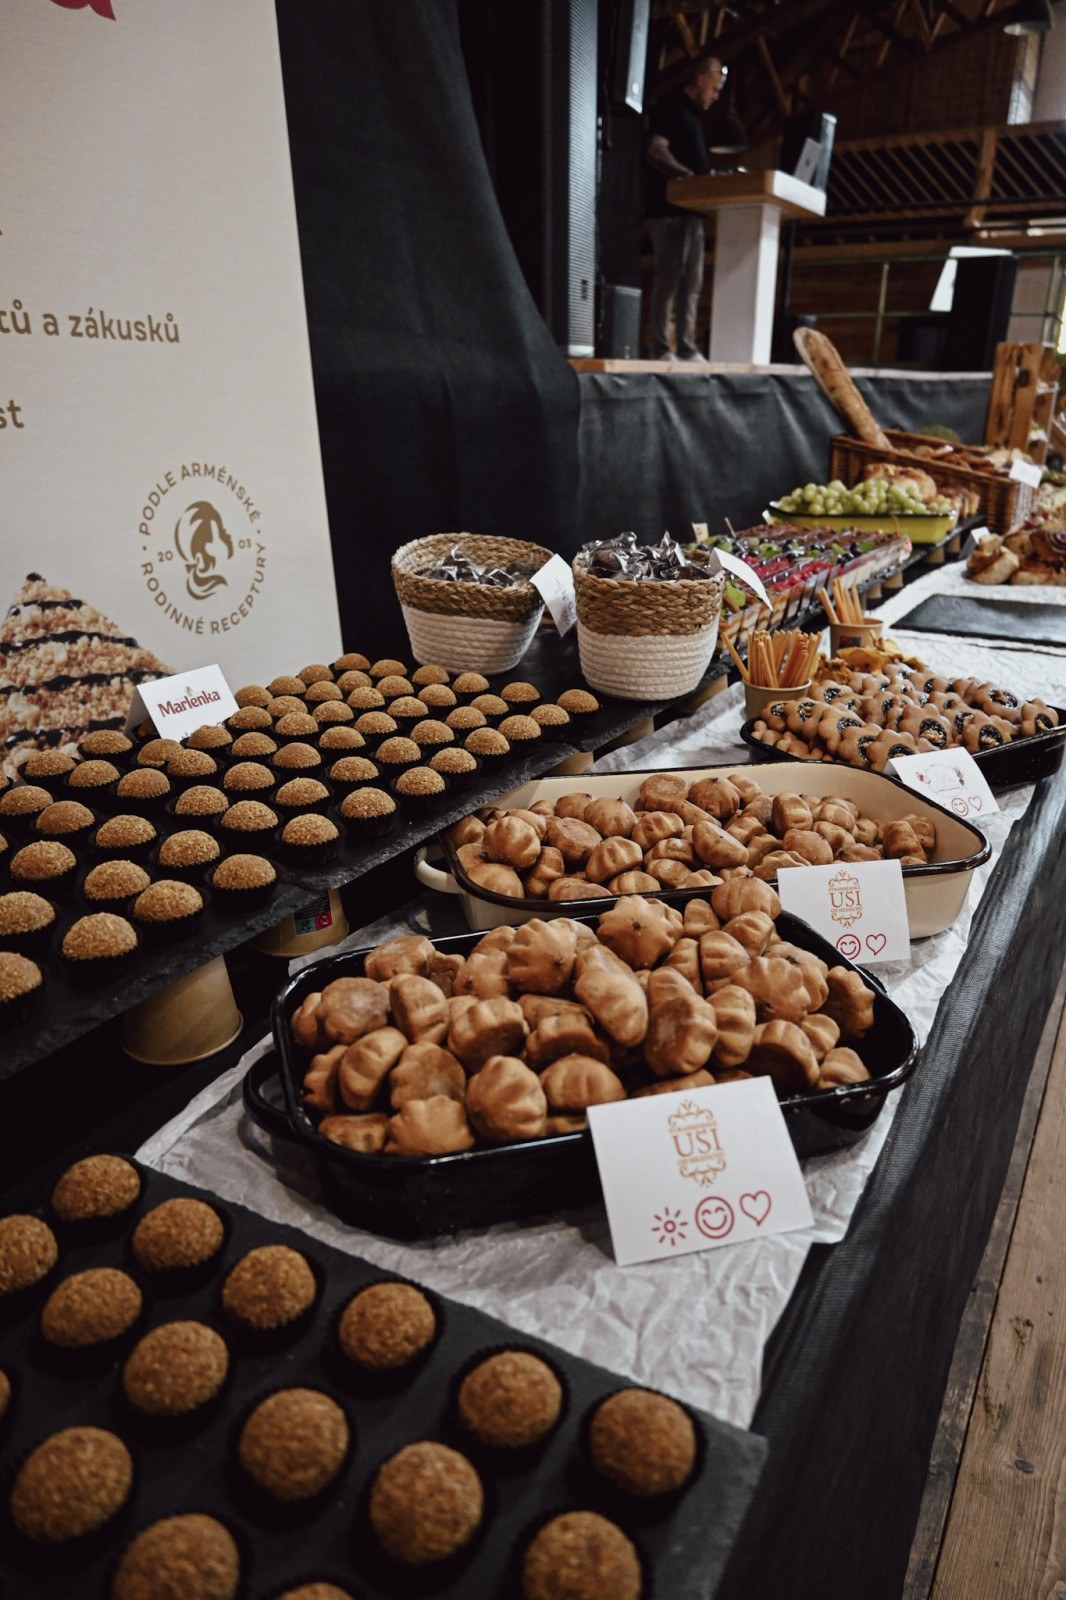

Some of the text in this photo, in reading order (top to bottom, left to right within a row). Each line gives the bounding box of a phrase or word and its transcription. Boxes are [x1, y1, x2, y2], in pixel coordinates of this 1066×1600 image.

[42, 312, 60, 337] a
[69, 307, 181, 343] zákusků
[138, 462, 262, 536] PODLE ARMÉNSKÉ
[157, 550, 174, 562] 20
[140, 542, 267, 635] RODINNÉ RECEPTURY
[157, 690, 222, 718] Marlenka
